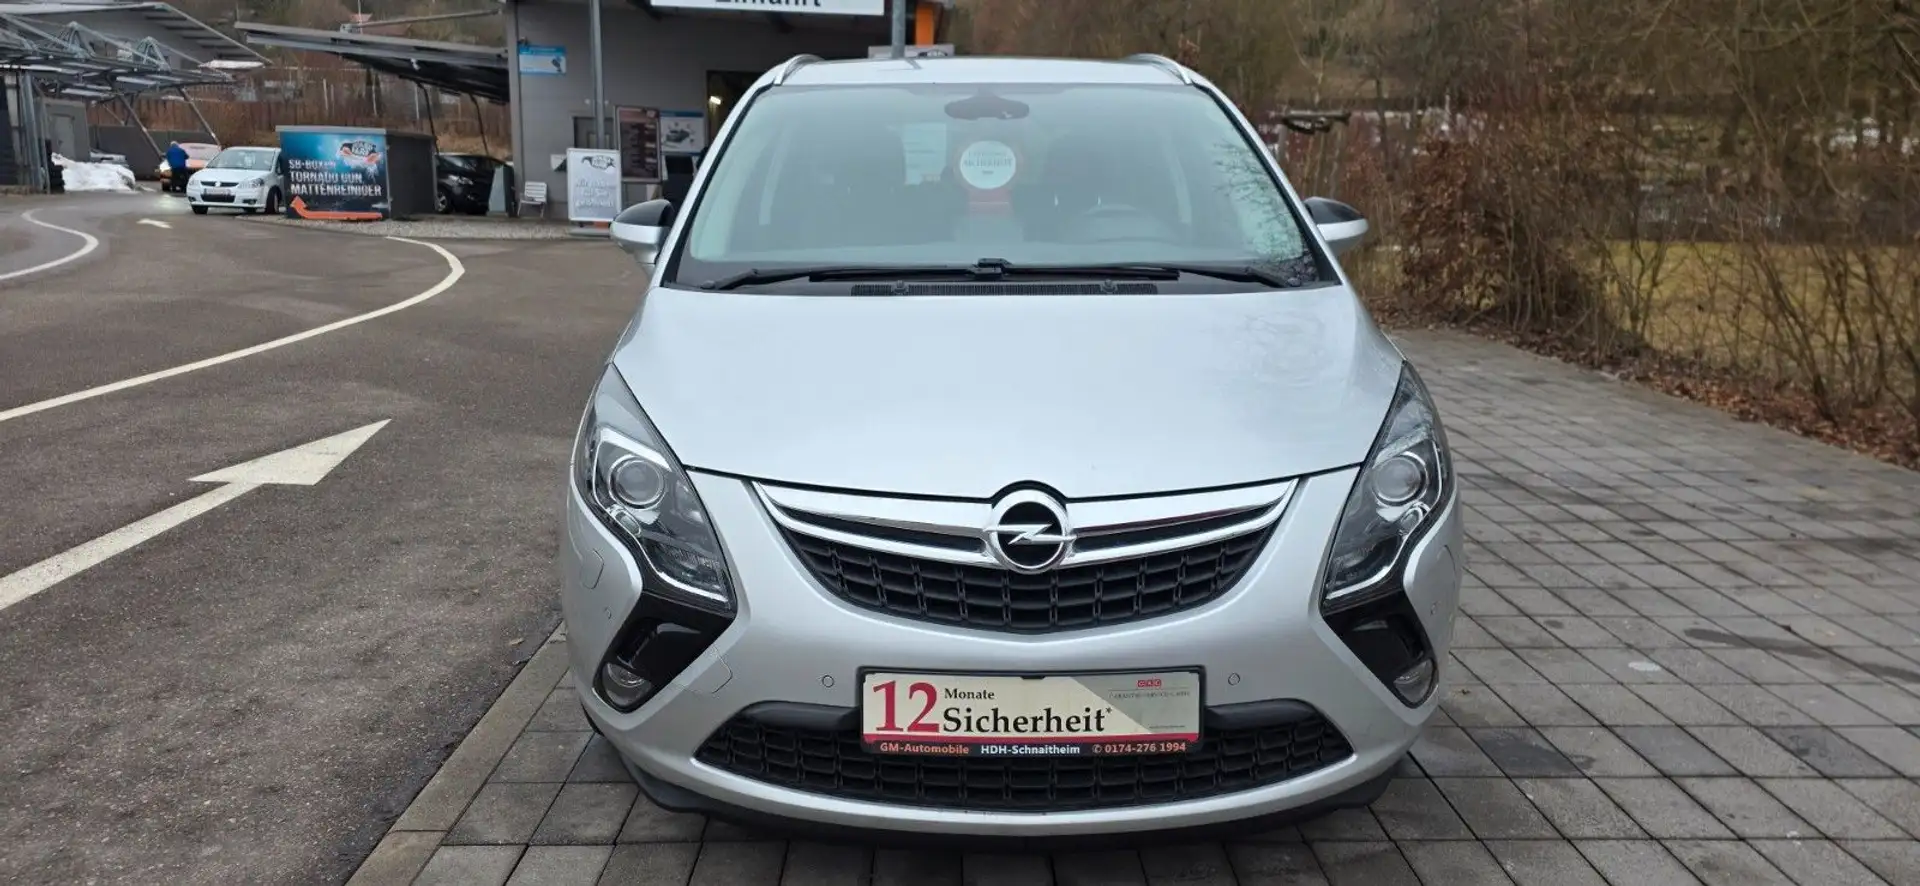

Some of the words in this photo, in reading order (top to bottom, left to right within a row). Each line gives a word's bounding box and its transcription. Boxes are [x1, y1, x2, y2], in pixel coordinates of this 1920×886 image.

[944, 688, 995, 700] Monate
[872, 680, 940, 733] 12
[880, 742, 970, 754] GM-Automobile
[981, 744, 1080, 755] HDH-Schnaitheim
[1105, 743, 1156, 753] 0174-276
[1160, 742, 1187, 752] 1994
